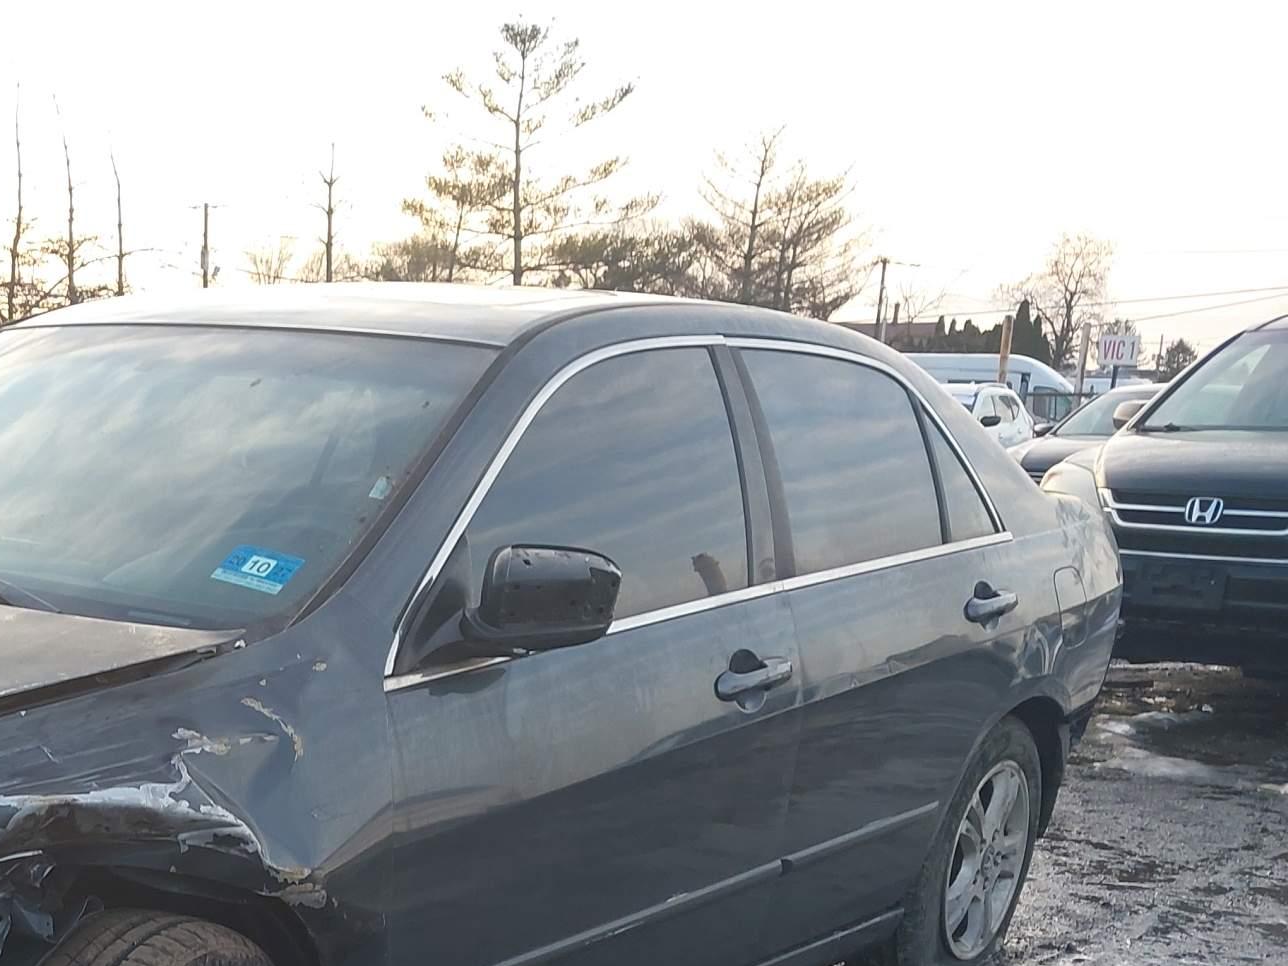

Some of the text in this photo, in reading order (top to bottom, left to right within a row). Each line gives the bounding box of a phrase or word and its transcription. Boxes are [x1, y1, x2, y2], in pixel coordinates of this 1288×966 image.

[1103, 339, 1136, 361] VIC 1
[248, 559, 272, 574] 10
